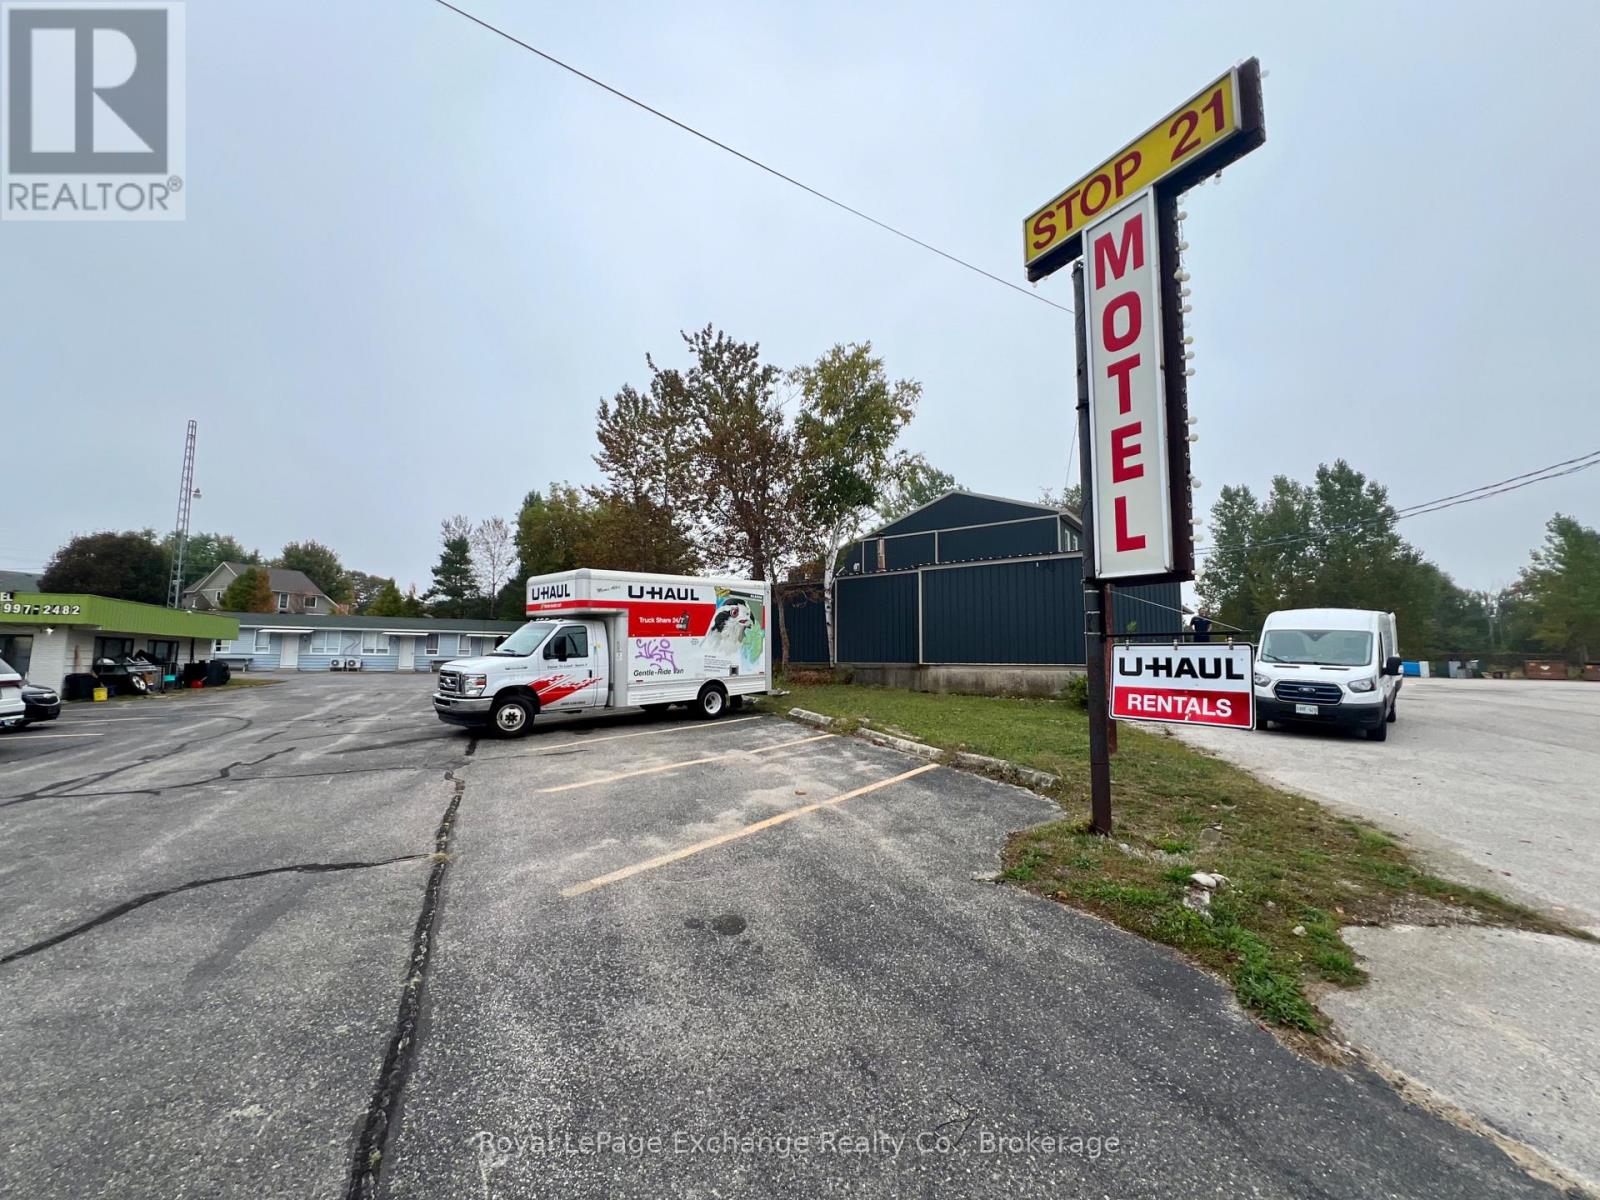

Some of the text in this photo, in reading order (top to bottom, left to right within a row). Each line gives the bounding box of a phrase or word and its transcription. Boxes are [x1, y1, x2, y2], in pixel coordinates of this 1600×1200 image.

[1033, 88, 1225, 250] STOP 21
[1094, 212, 1146, 553] MOTEL
[531, 583, 570, 600] U-HAUL
[627, 585, 700, 601] U-HAUL
[3, 603, 80, 615] 997-2482
[638, 616, 655, 624] Truck
[655, 616, 672, 624] Share
[1119, 656, 1244, 680] U-HAUL
[1127, 693, 1232, 717] RENTALS
